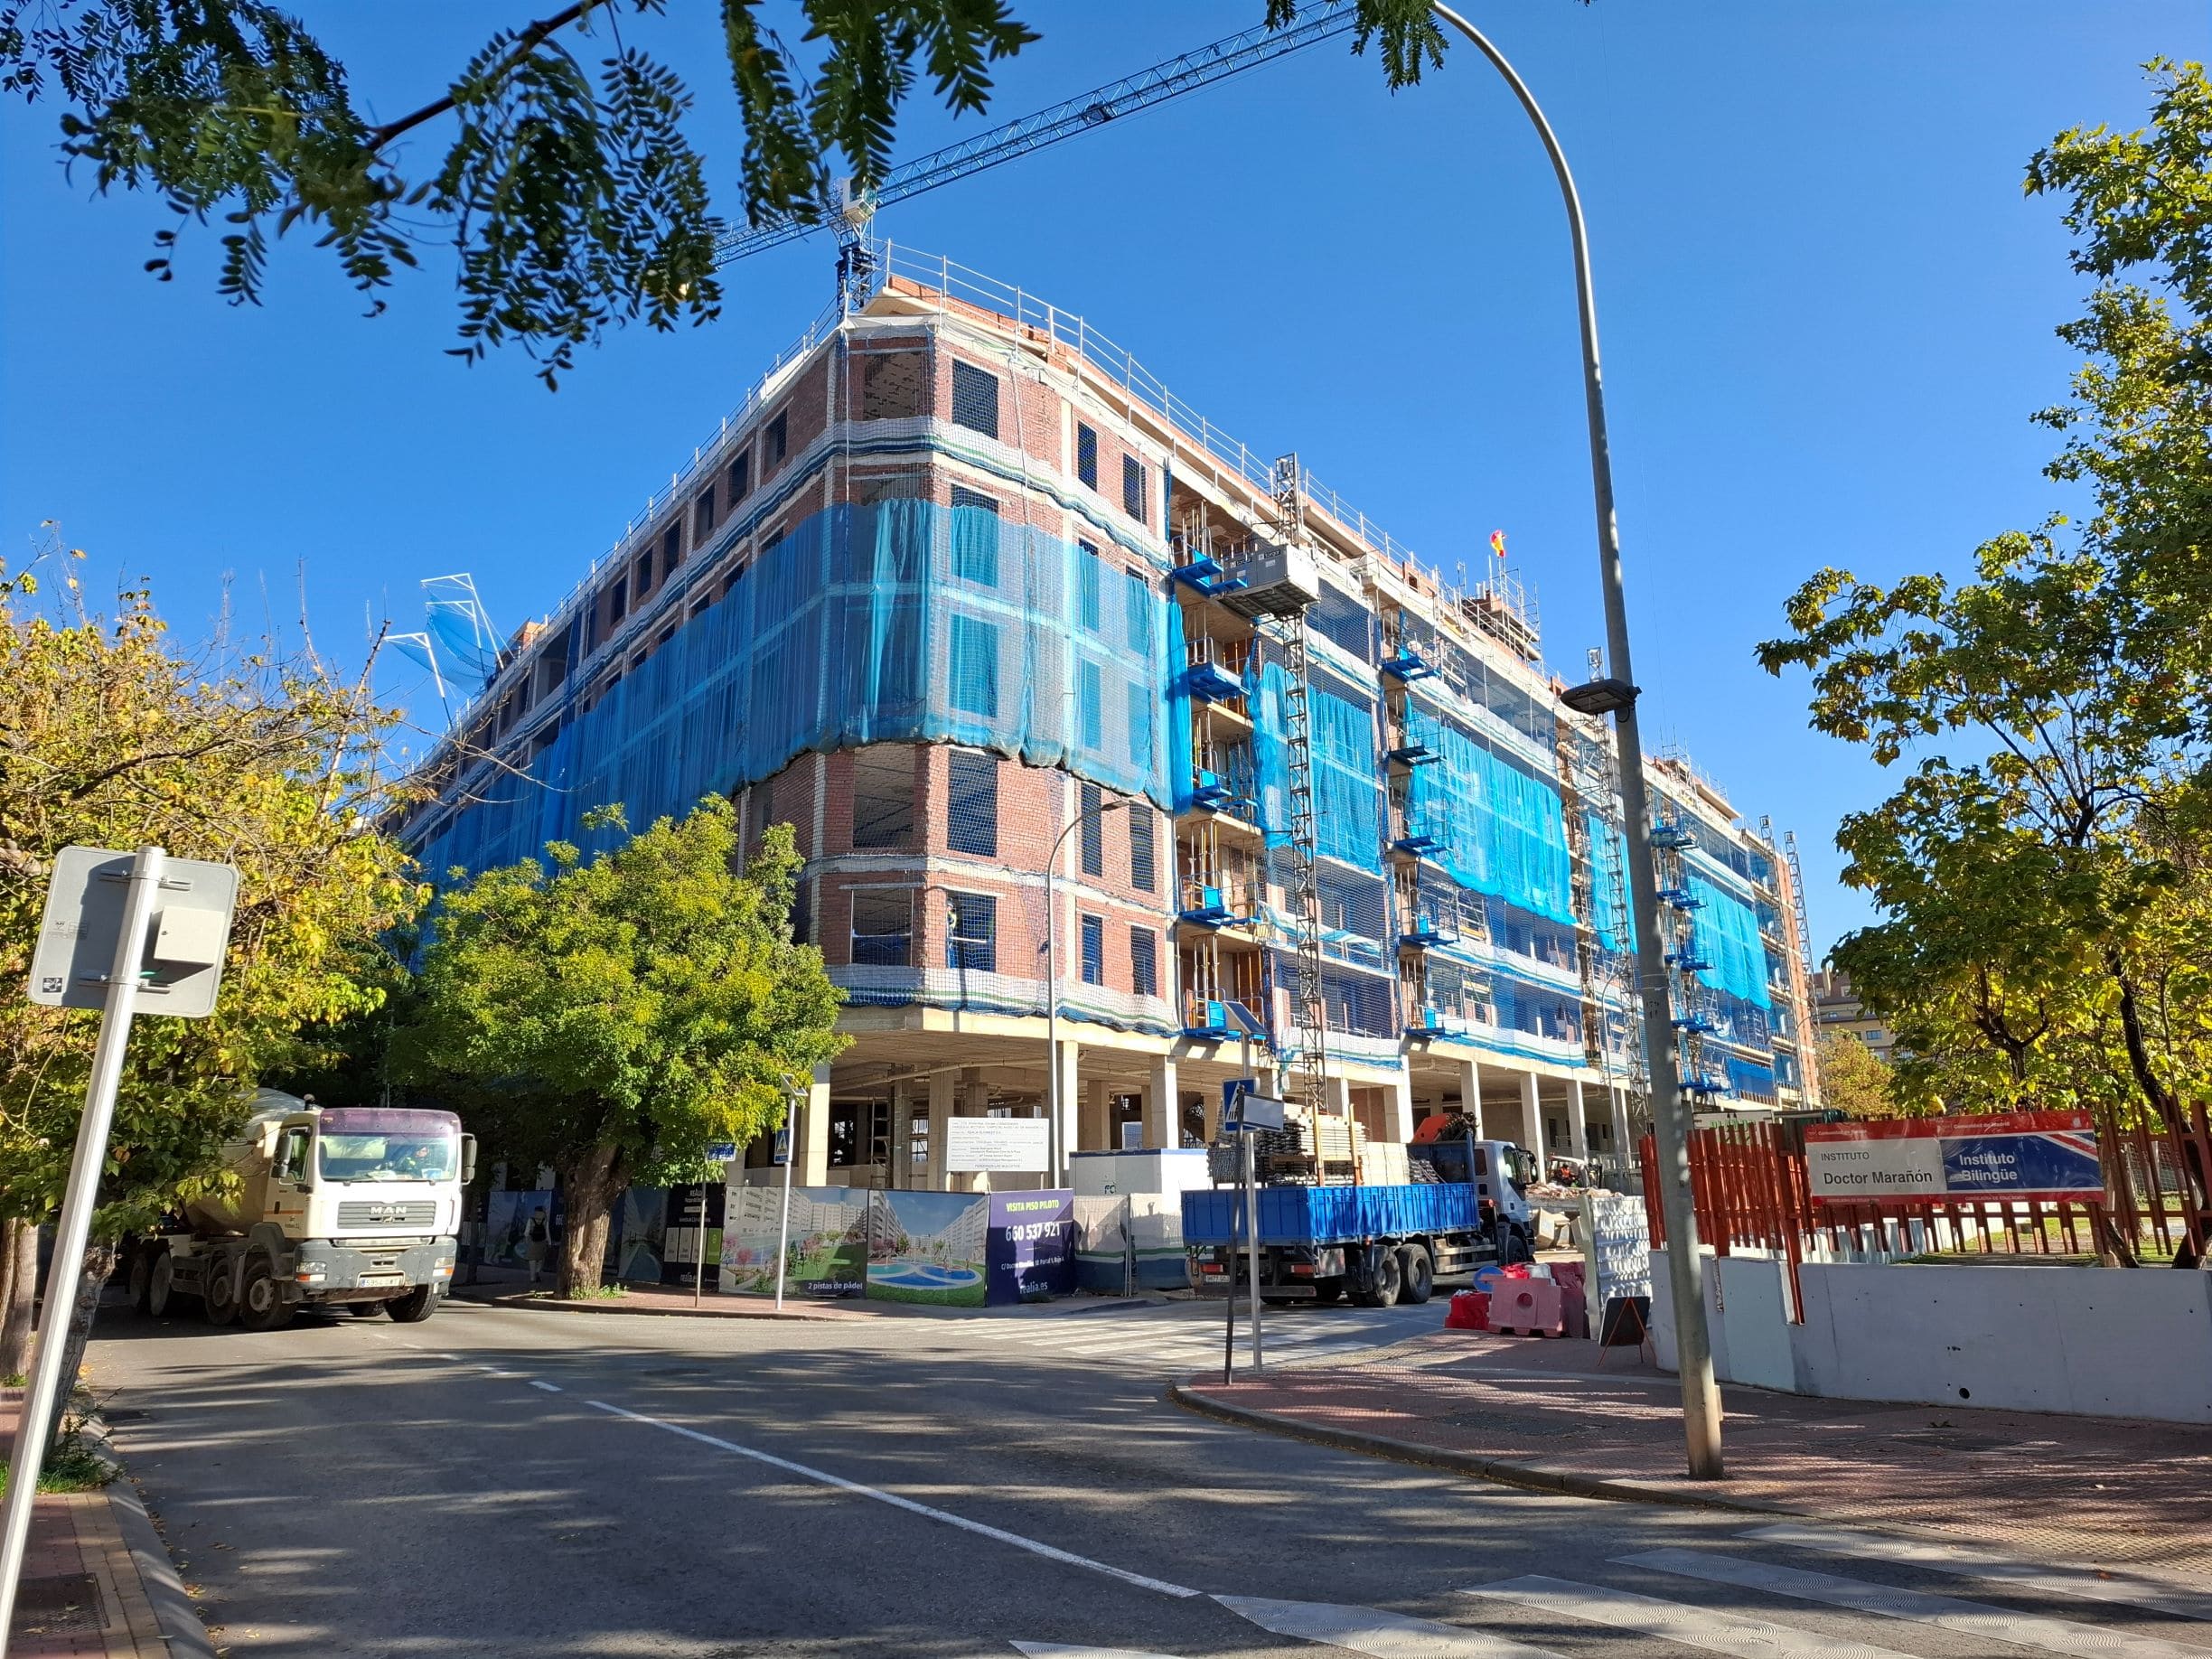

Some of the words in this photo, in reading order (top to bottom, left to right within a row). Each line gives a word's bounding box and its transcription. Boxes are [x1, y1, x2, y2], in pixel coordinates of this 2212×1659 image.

[1821, 1151, 1870, 1161] INSTITUTO
[1959, 1153, 2015, 1166] Instituto
[1823, 1172, 1868, 1185] Doctor
[1872, 1169, 1933, 1184] Marañón
[1962, 1168, 2018, 1184] Bilingüe
[370, 1206, 407, 1214] MAN
[1006, 1202, 1025, 1212] VISITA
[1026, 1201, 1038, 1211] PISO
[1039, 1199, 1059, 1210] PILOTO
[1006, 1225, 1024, 1242] 660
[1026, 1223, 1042, 1240] 537
[1045, 1221, 1060, 1237] 921
[813, 1281, 832, 1290] pistas
[843, 1281, 863, 1291] pádel
[1019, 1280, 1048, 1294] realia.es
